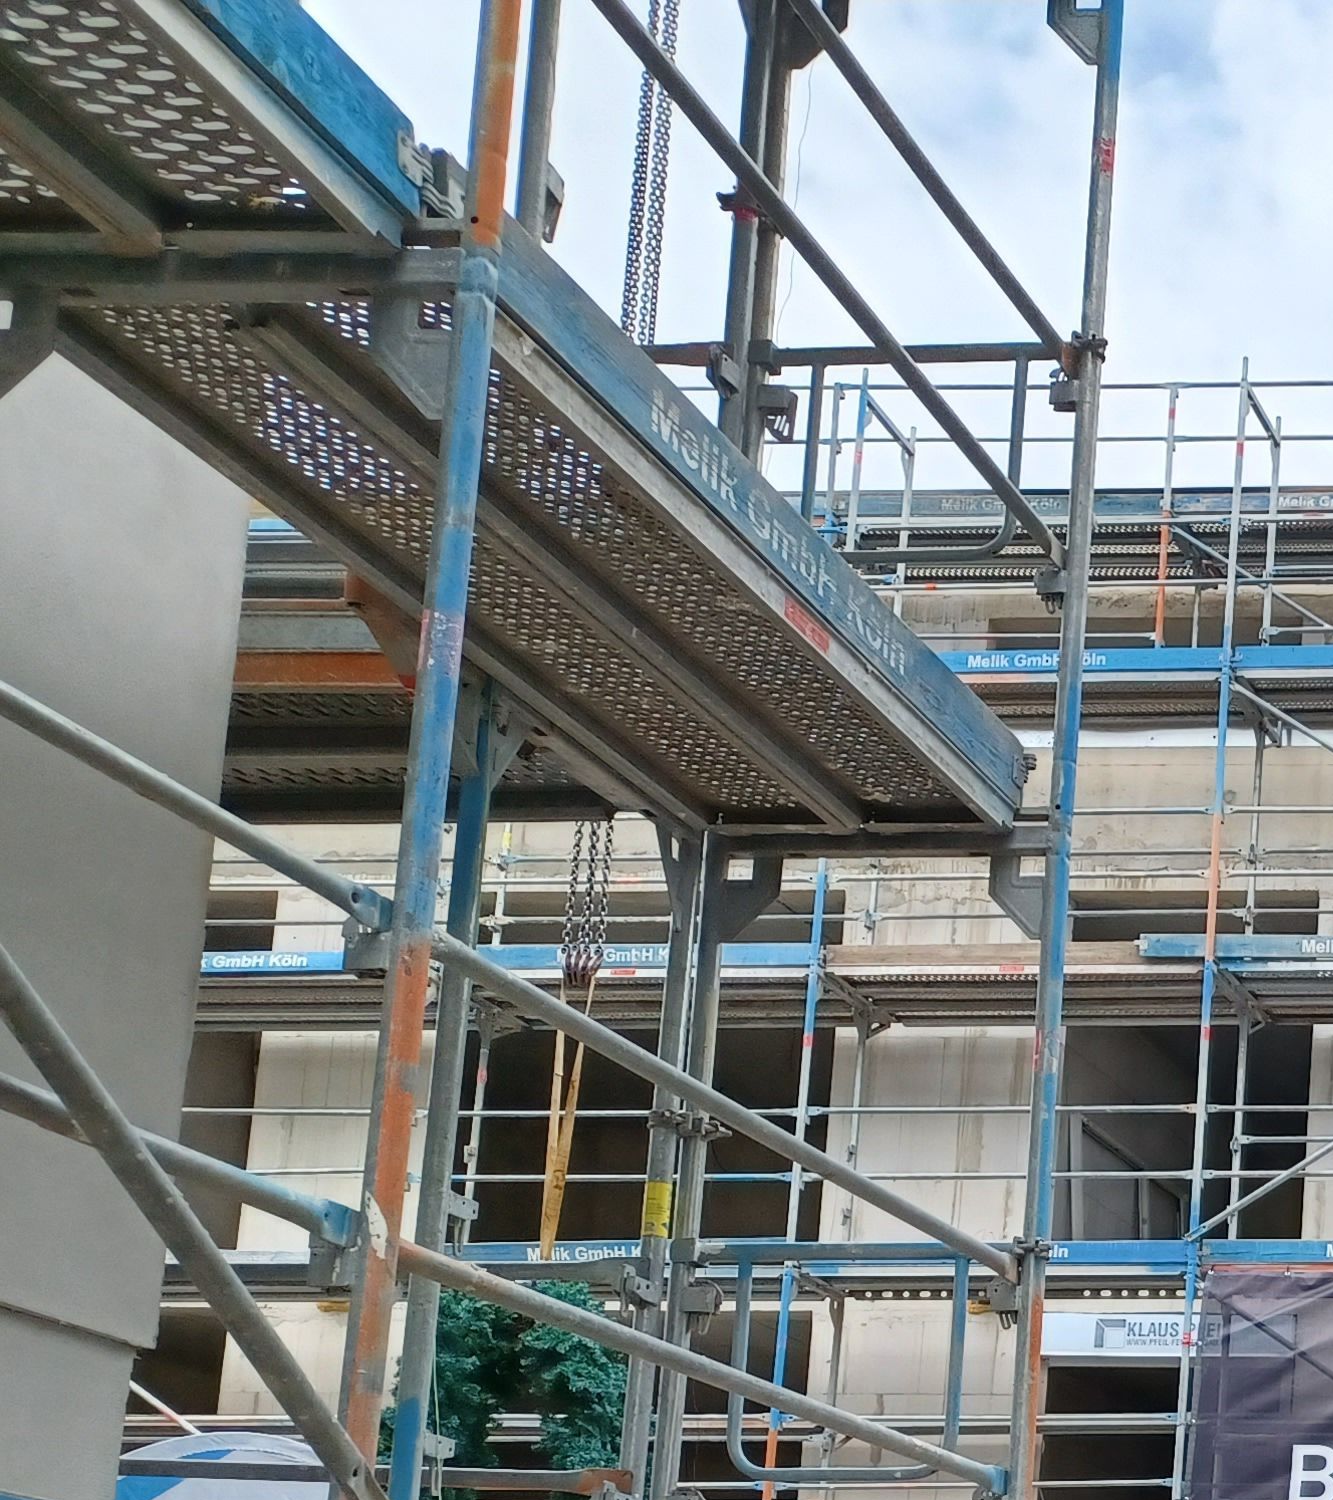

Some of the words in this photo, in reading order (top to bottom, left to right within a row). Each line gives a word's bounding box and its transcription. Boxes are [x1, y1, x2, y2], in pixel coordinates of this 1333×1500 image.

[967, 654, 1009, 668] Melik
[212, 955, 264, 968] GmbH
[269, 954, 307, 968] Köln
[603, 948, 654, 963] GmbH
[527, 1247, 571, 1261] Mlik
[1127, 1322, 1179, 1337] KLAUS
